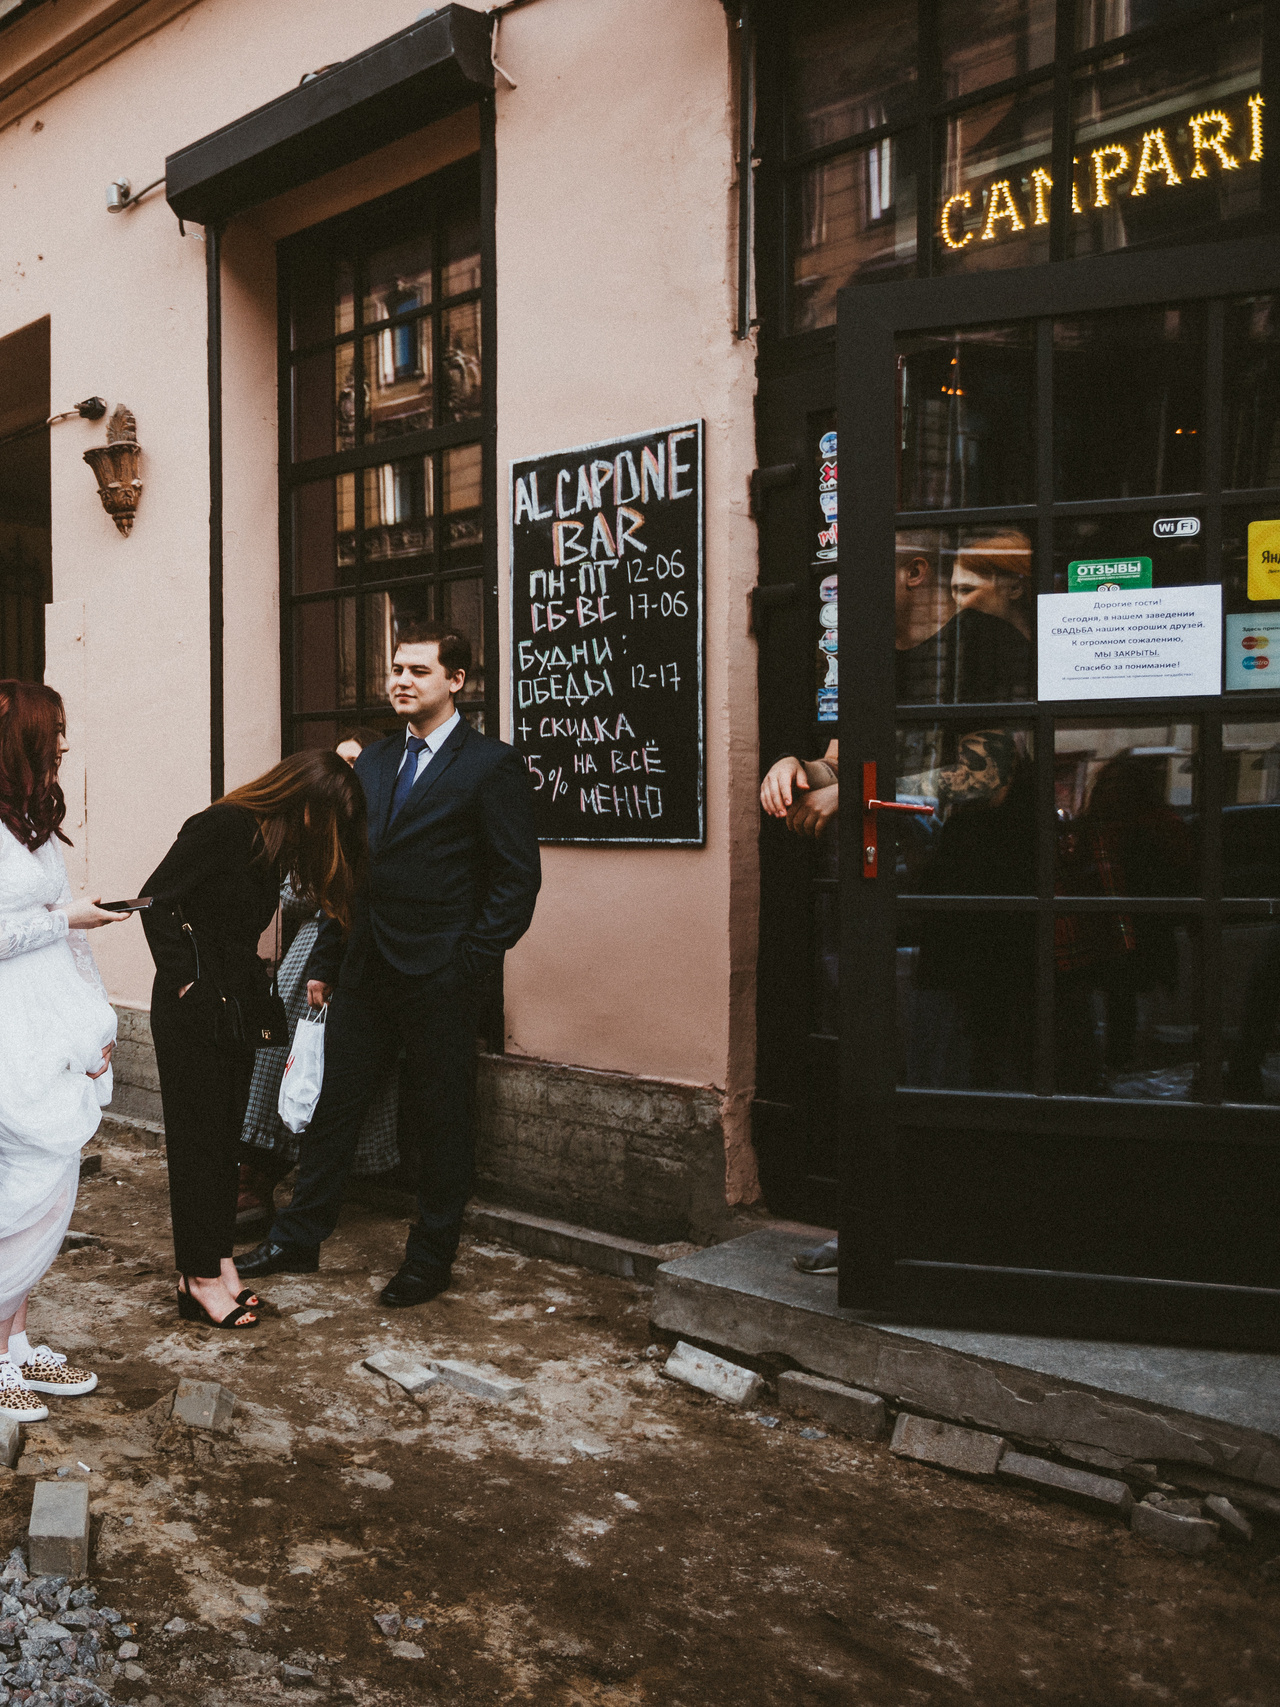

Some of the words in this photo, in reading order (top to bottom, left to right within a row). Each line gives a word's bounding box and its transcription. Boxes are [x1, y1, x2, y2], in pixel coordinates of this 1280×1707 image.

[514, 471, 553, 525] AL
[556, 429, 696, 519] CAPONE
[552, 506, 648, 566] BAR
[529, 559, 619, 598] ПН-ПТ
[626, 549, 685, 583] 12-06
[1077, 562, 1141, 576] ОТЗЫВЫ
[531, 595, 617, 634] СБ-ВС
[630, 590, 688, 620] 17-06
[1093, 601, 1132, 609] Дорогие
[1134, 599, 1162, 607] гости!
[1145, 611, 1195, 619] заведении
[1051, 627, 1093, 635] СВАДЬБА
[1127, 624, 1167, 632] хороших
[1169, 621, 1206, 631] друзей.
[1080, 638, 1126, 646] огромном
[1128, 636, 1183, 644] сожалению,
[1074, 664, 1111, 672] Спасибо
[1125, 661, 1180, 670] понимание!
[1114, 649, 1160, 657] ЗАКРЫТЫ.
[518, 669, 613, 709] ОБЕДЫ
[631, 662, 681, 691] 12-17
[540, 713, 636, 747] СКИДКА
[523, 755, 568, 802] 5%
[574, 753, 597, 774] НА
[611, 739, 666, 774] ВСЁ
[580, 783, 663, 819] МЕНЮ
